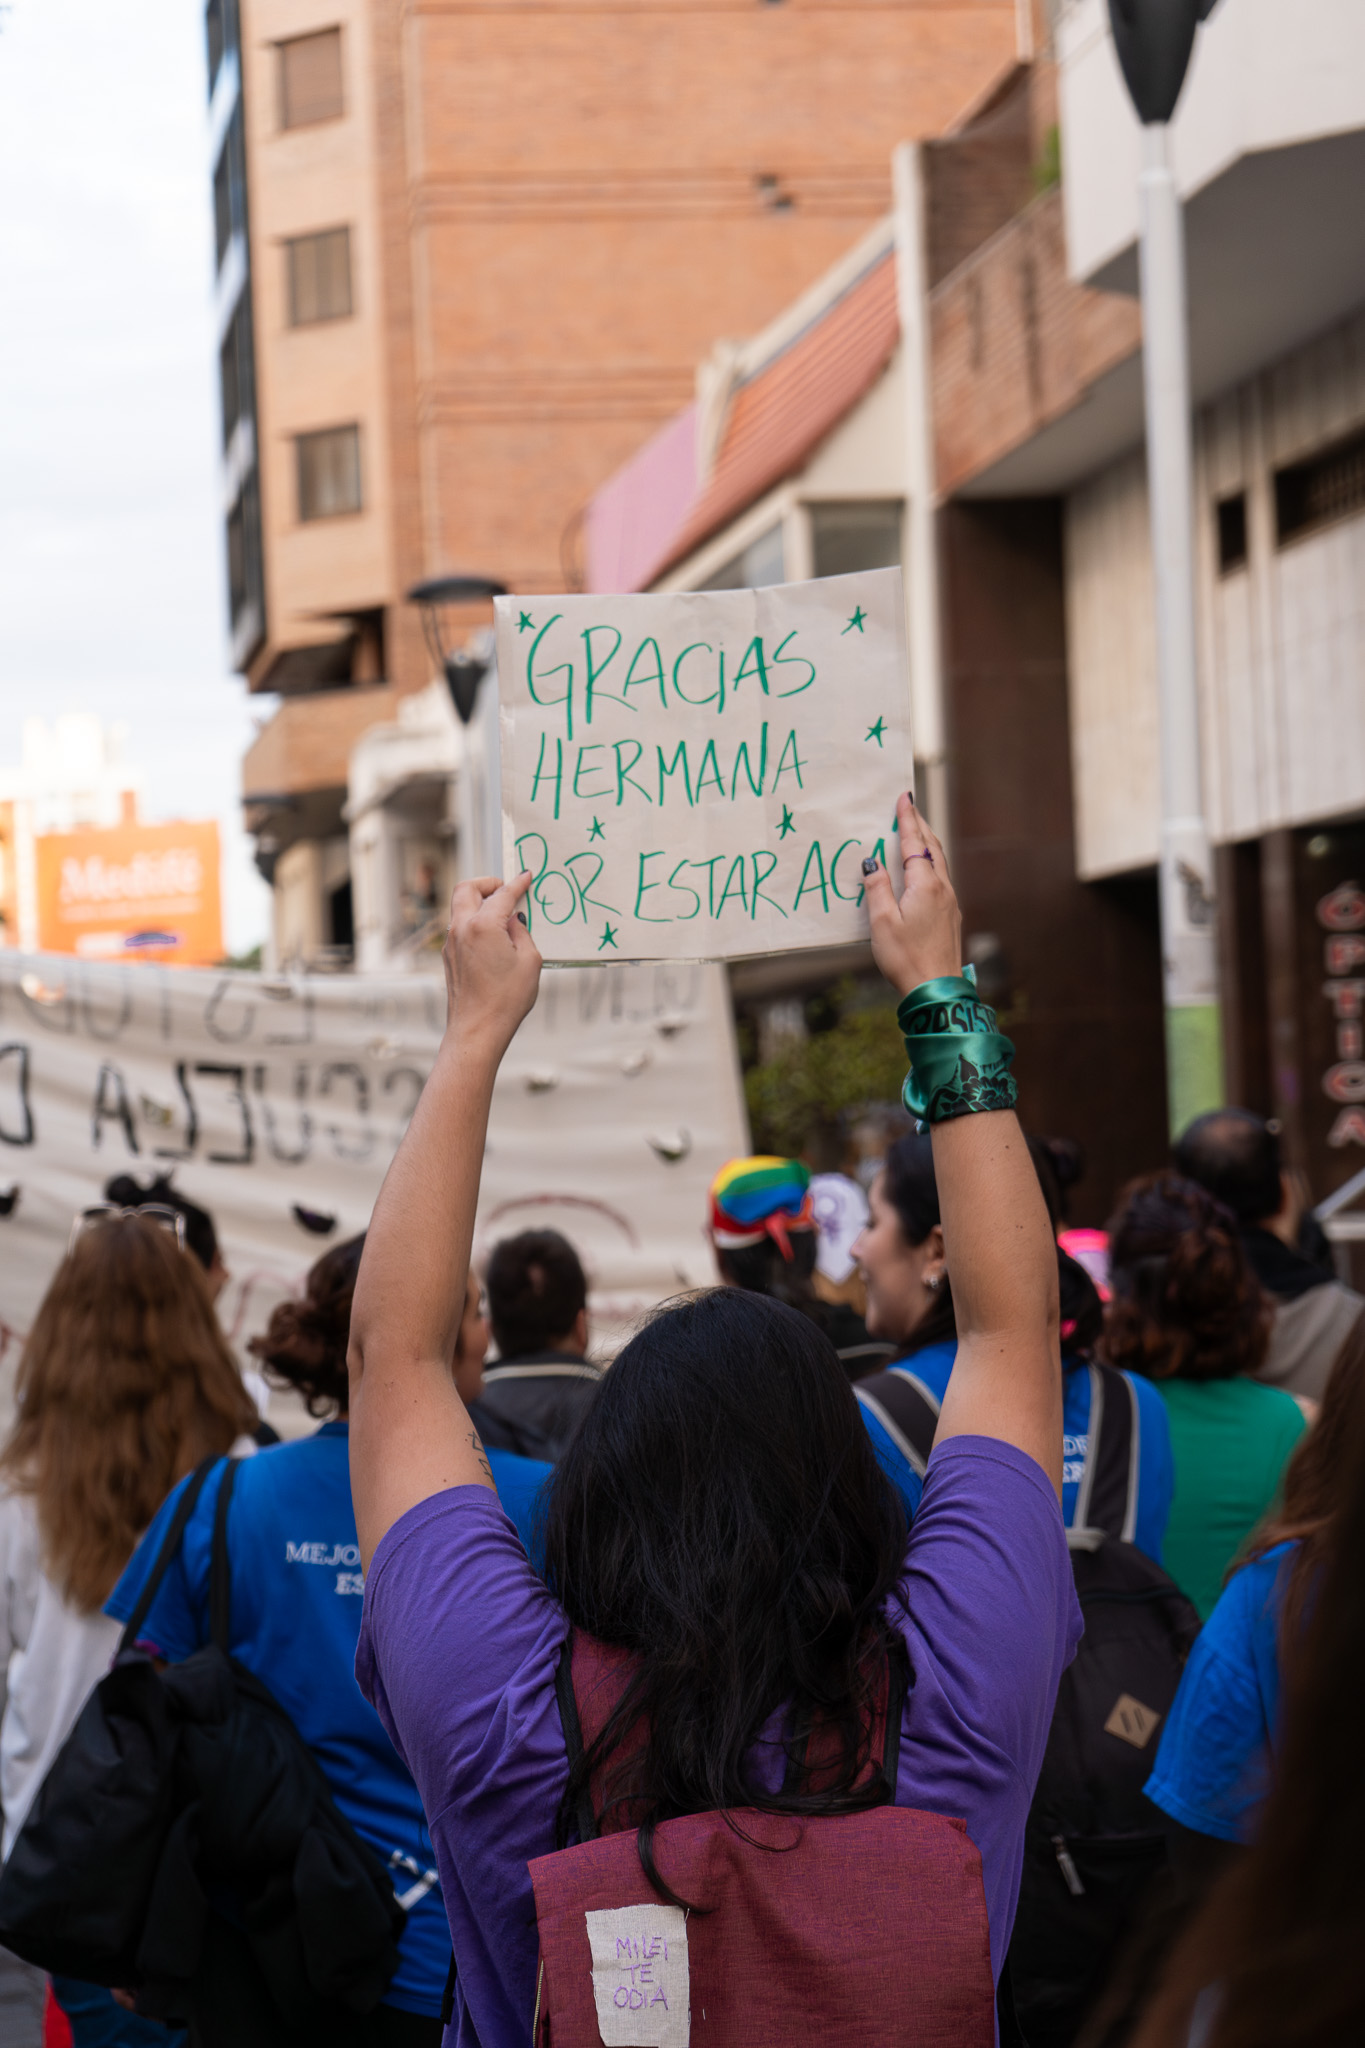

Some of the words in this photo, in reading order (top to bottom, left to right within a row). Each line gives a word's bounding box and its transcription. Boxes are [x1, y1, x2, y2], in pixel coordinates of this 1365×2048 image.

[527, 613, 816, 741] GRACIAS
[530, 721, 809, 820] HERMANA
[514, 832, 622, 934] POR
[633, 850, 789, 922] ESTAR
[615, 1931, 669, 1962] MILEI
[621, 1962, 654, 1985] TE
[613, 1985, 669, 2012] ODIA
